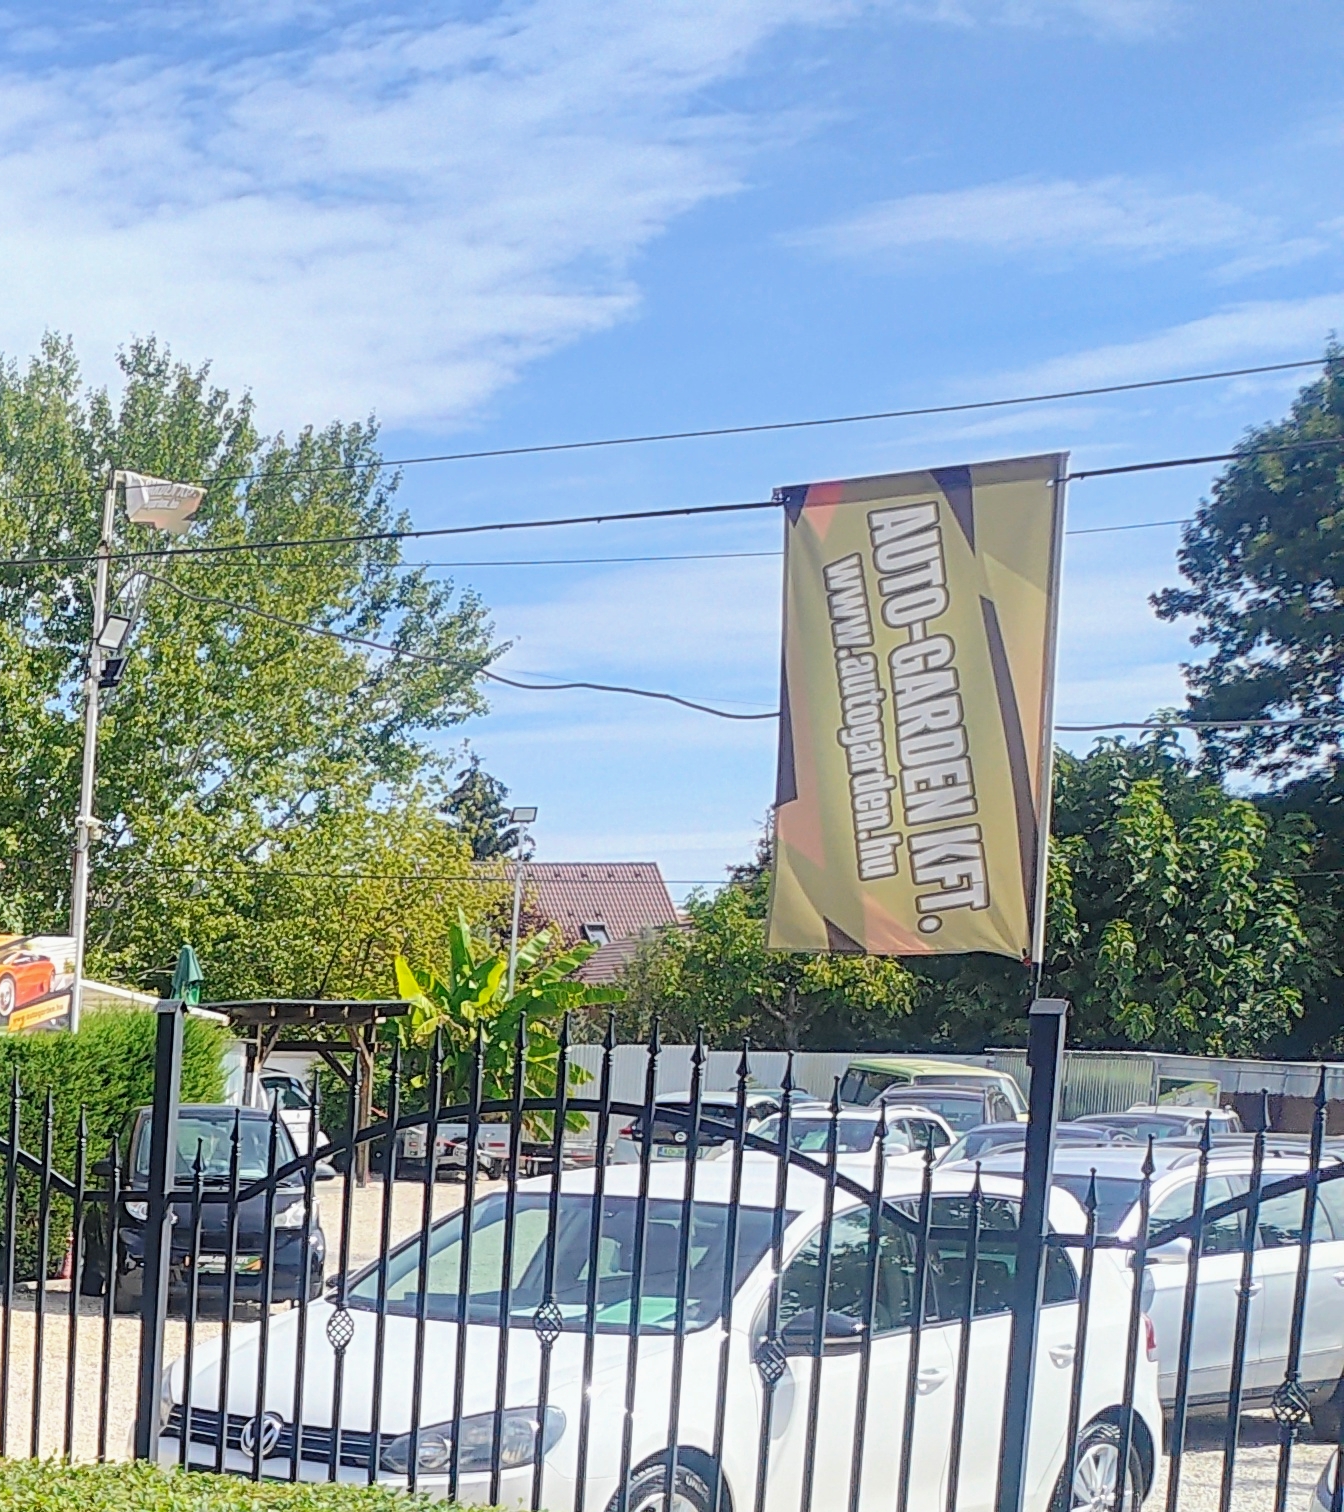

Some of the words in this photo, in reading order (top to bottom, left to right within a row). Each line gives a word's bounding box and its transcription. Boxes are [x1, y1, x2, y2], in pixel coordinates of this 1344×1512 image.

[823, 552, 903, 881] www.autogarden.hu
[866, 500, 977, 823] AUTO-GARDEN
[909, 823, 991, 933] KFT.
